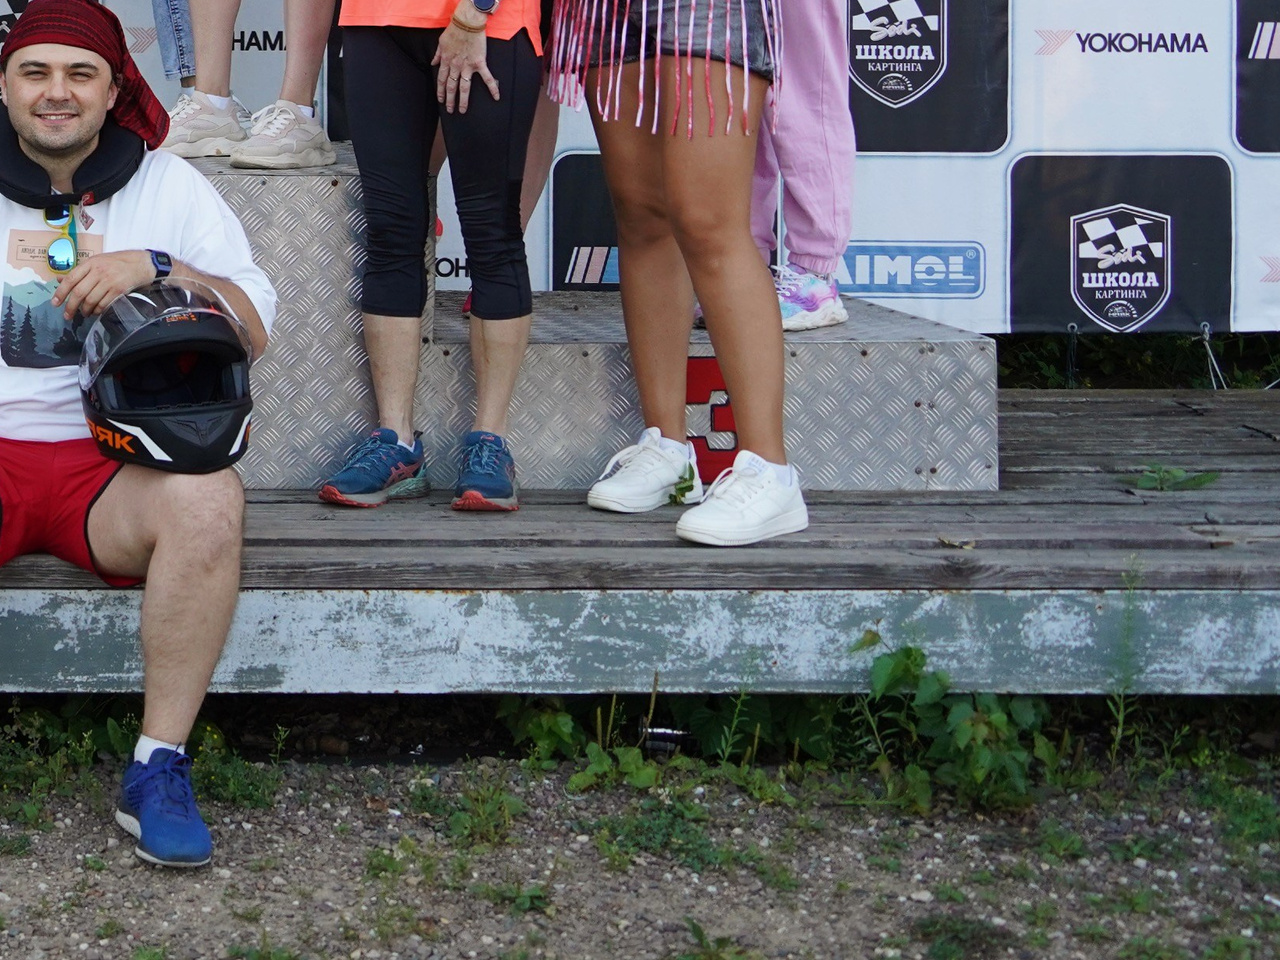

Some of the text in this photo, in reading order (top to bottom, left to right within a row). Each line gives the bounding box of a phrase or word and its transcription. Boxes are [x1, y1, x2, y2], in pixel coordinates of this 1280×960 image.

[1076, 33, 1208, 53] YOKOHAMA
[856, 45, 934, 60] ШКОЛА
[868, 63, 922, 72] КАРТИНГА
[1082, 272, 1159, 287] ШКОЛА
[1095, 290, 1147, 298] КАРТИНГА
